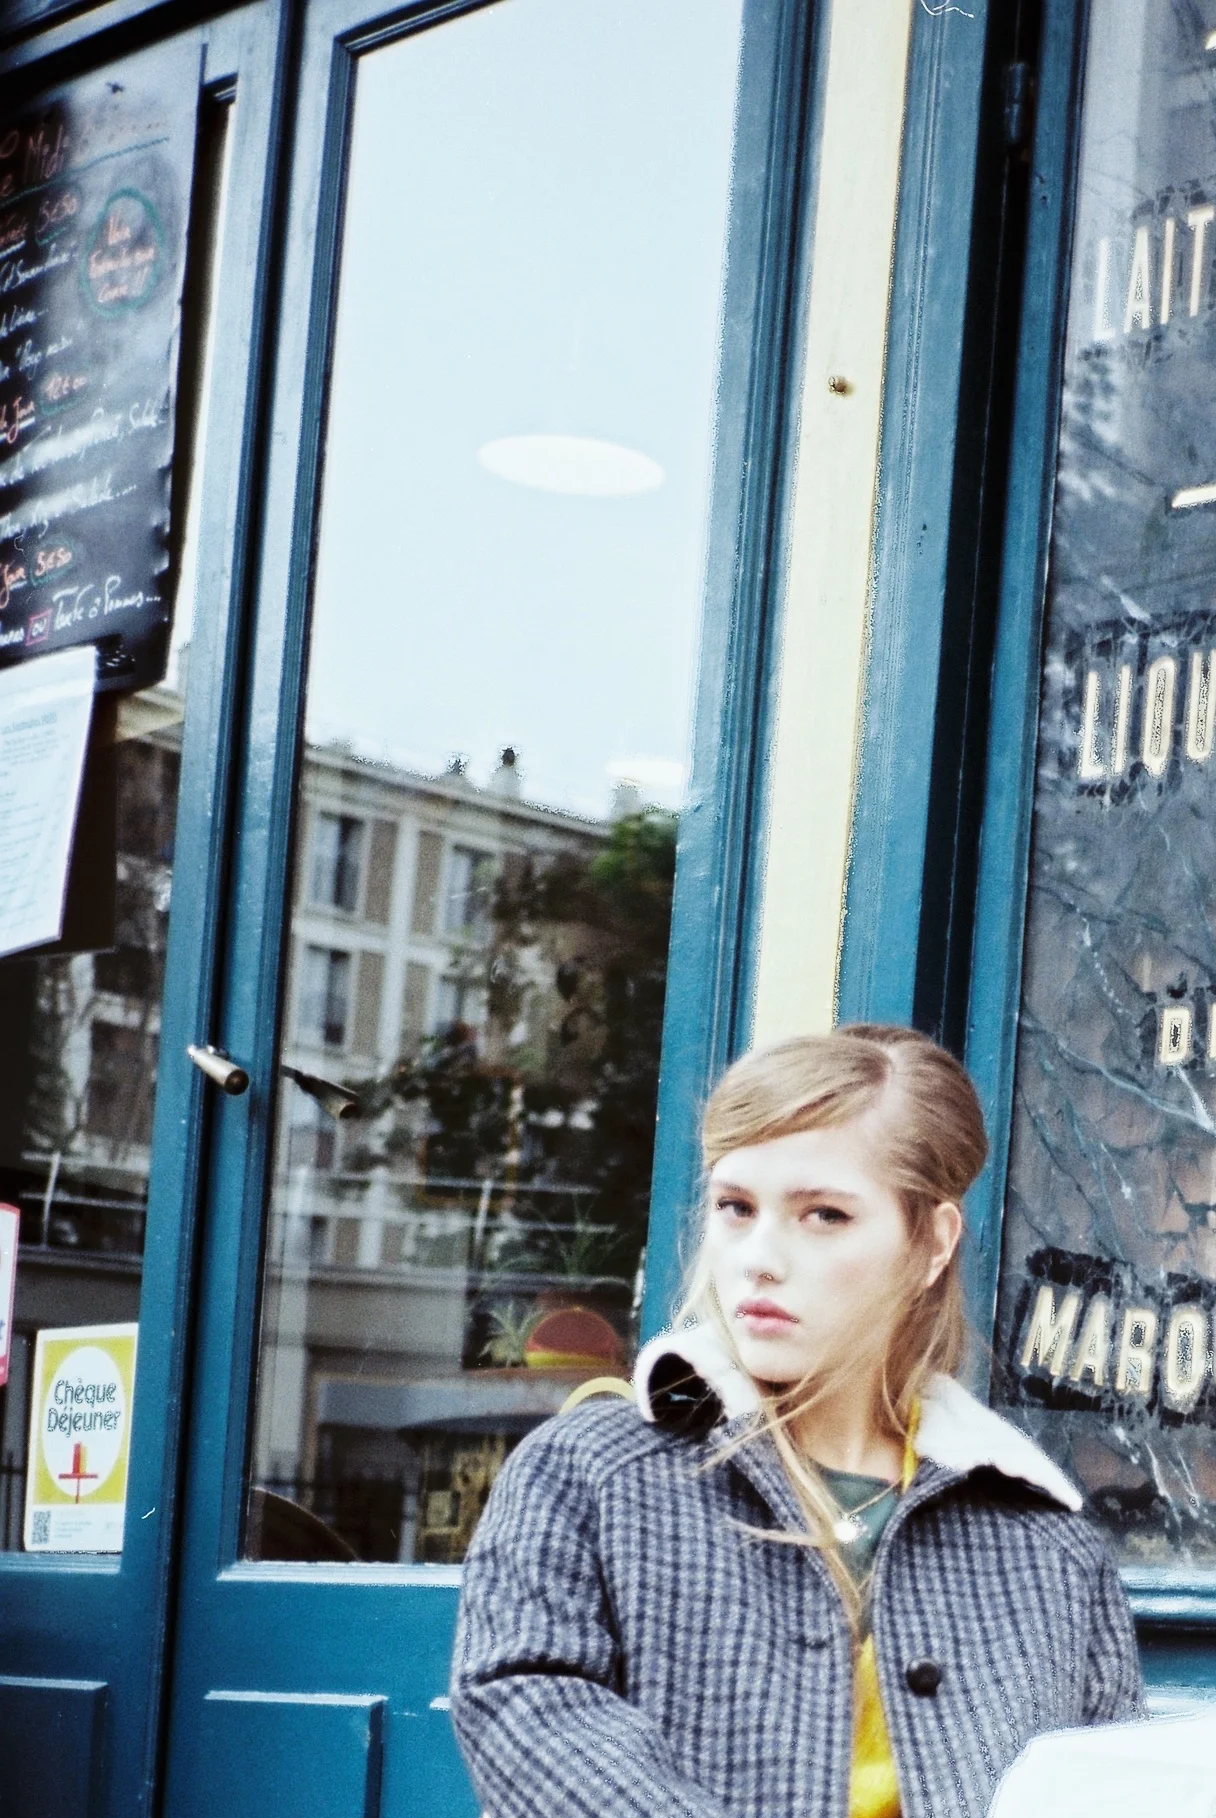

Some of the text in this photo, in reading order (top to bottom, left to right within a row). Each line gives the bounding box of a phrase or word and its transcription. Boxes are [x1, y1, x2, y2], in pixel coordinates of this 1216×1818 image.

[1091, 204, 1215, 342] LAIT
[54, 1378, 117, 1408] Chèque
[47, 1405, 122, 1438] Déjeuner
